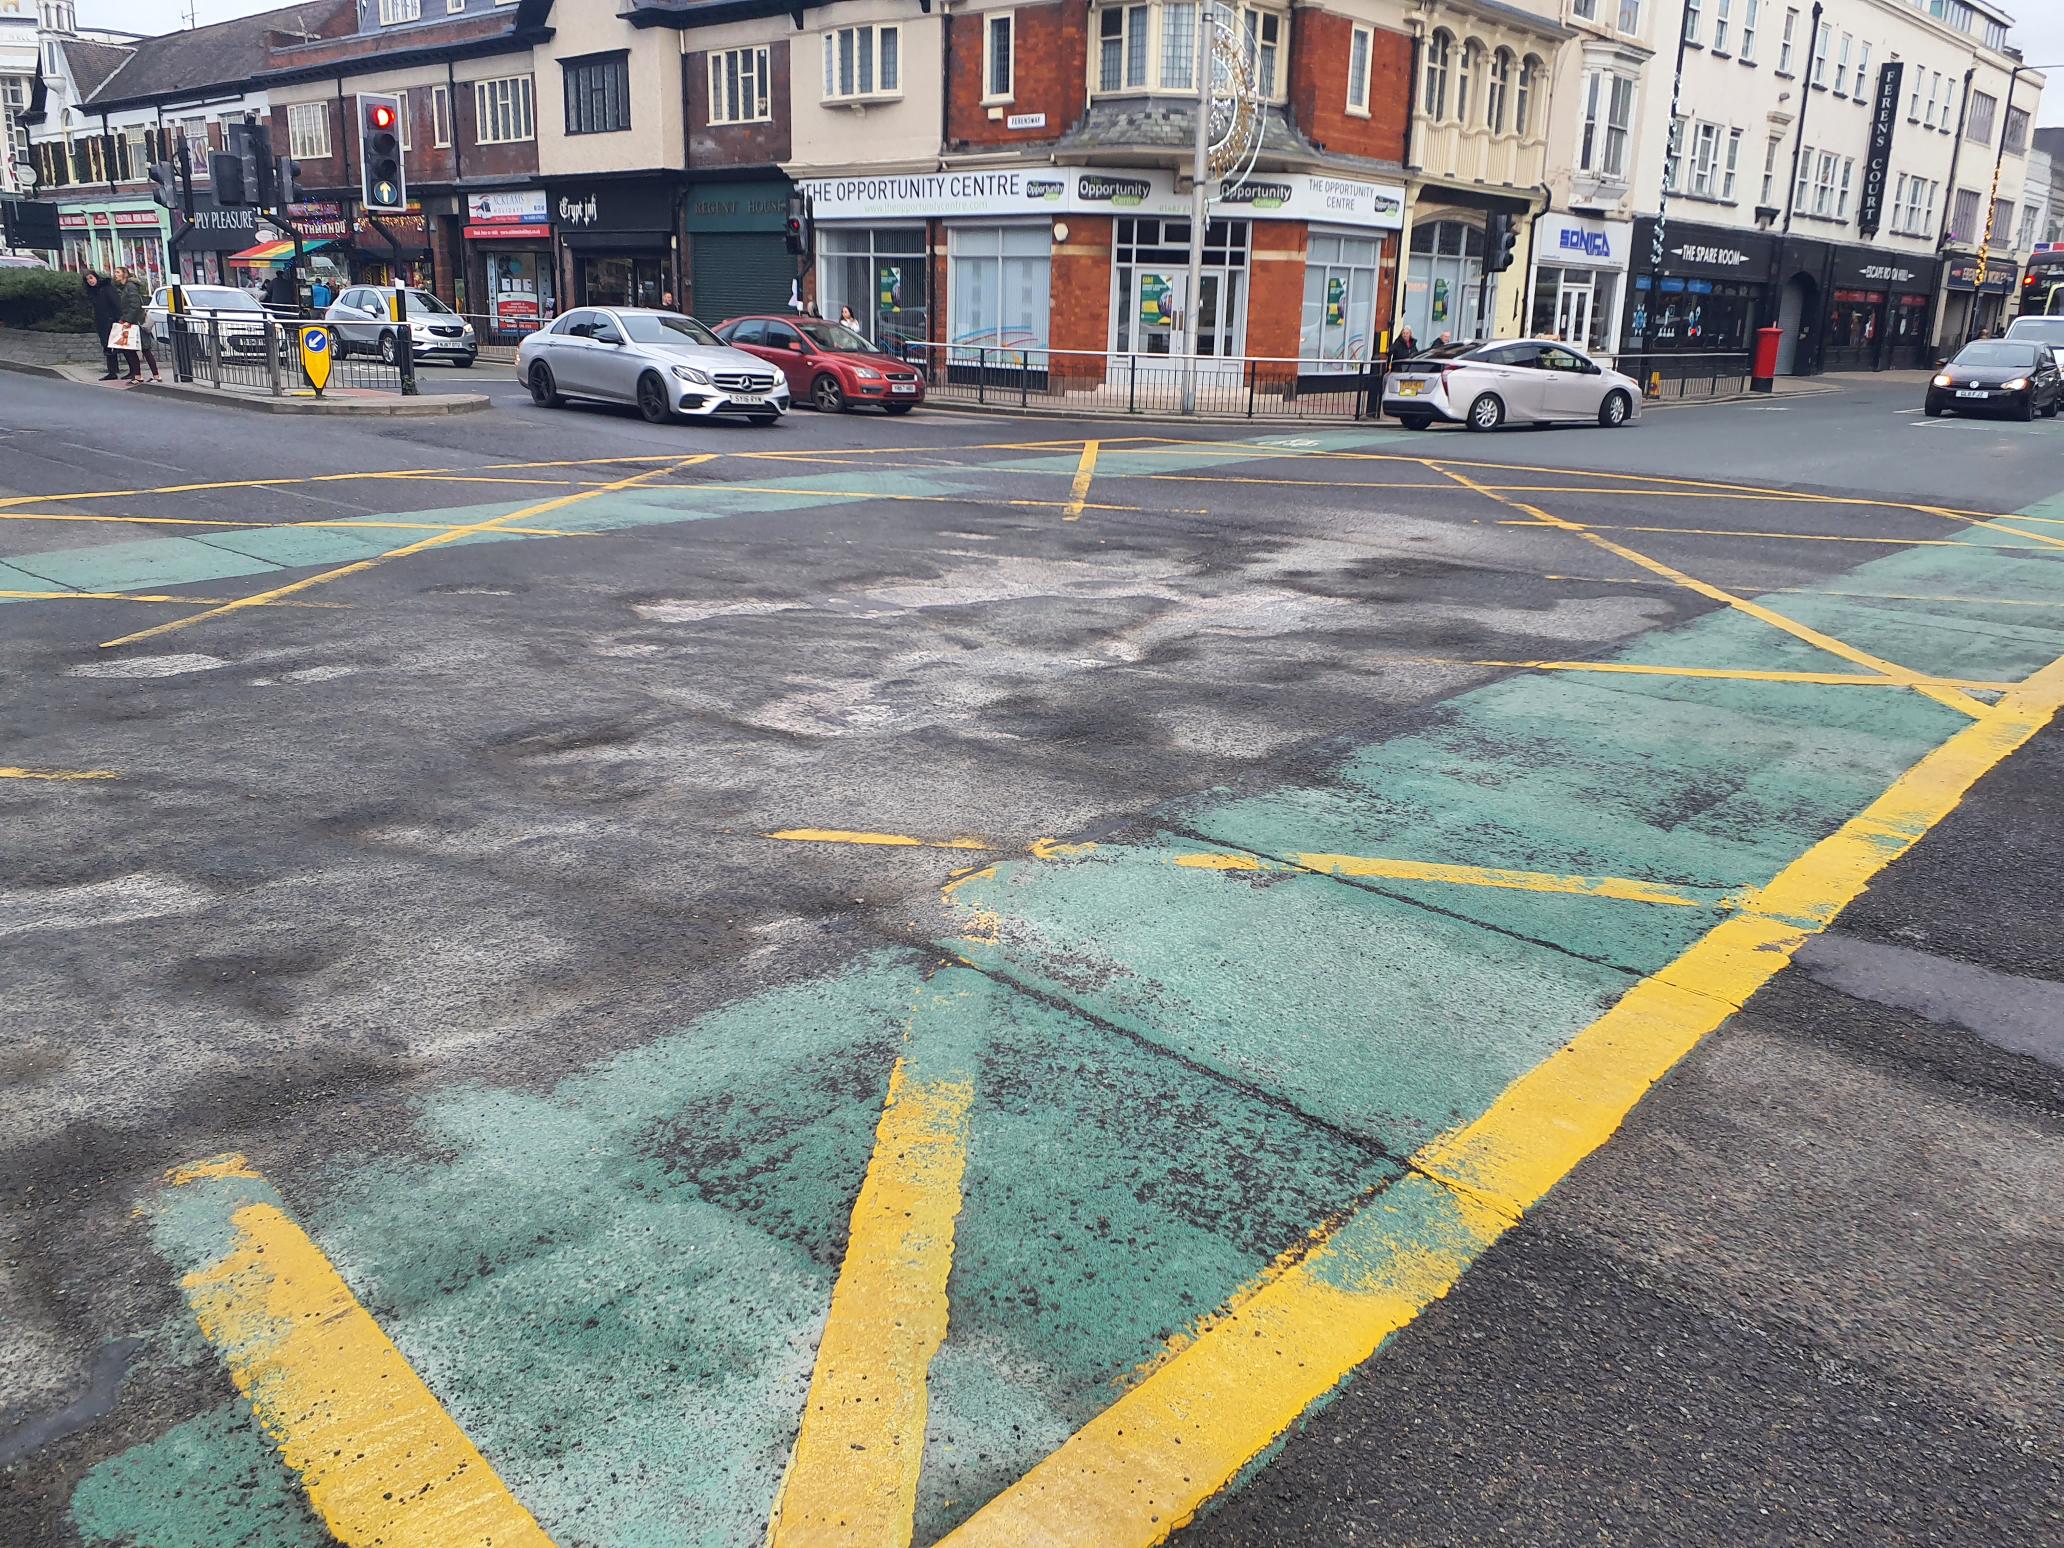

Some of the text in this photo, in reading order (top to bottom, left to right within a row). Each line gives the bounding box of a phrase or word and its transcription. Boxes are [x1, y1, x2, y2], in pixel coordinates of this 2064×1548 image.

[1865, 70, 1895, 220] FERENS COURT
[806, 174, 1020, 202] THE OPPORTUNITY CENTRE
[1080, 181, 1149, 198] Opportunity
[1221, 183, 1291, 201] Opportunity
[1309, 179, 1374, 199] THE OPPORTUNITY
[559, 195, 583, 226] Crypt
[696, 201, 736, 214] REGENT
[1327, 196, 1355, 211] CENTRE
[211, 210, 254, 229] PLEASURE
[1682, 244, 1740, 265] THE SPARE ROOM
